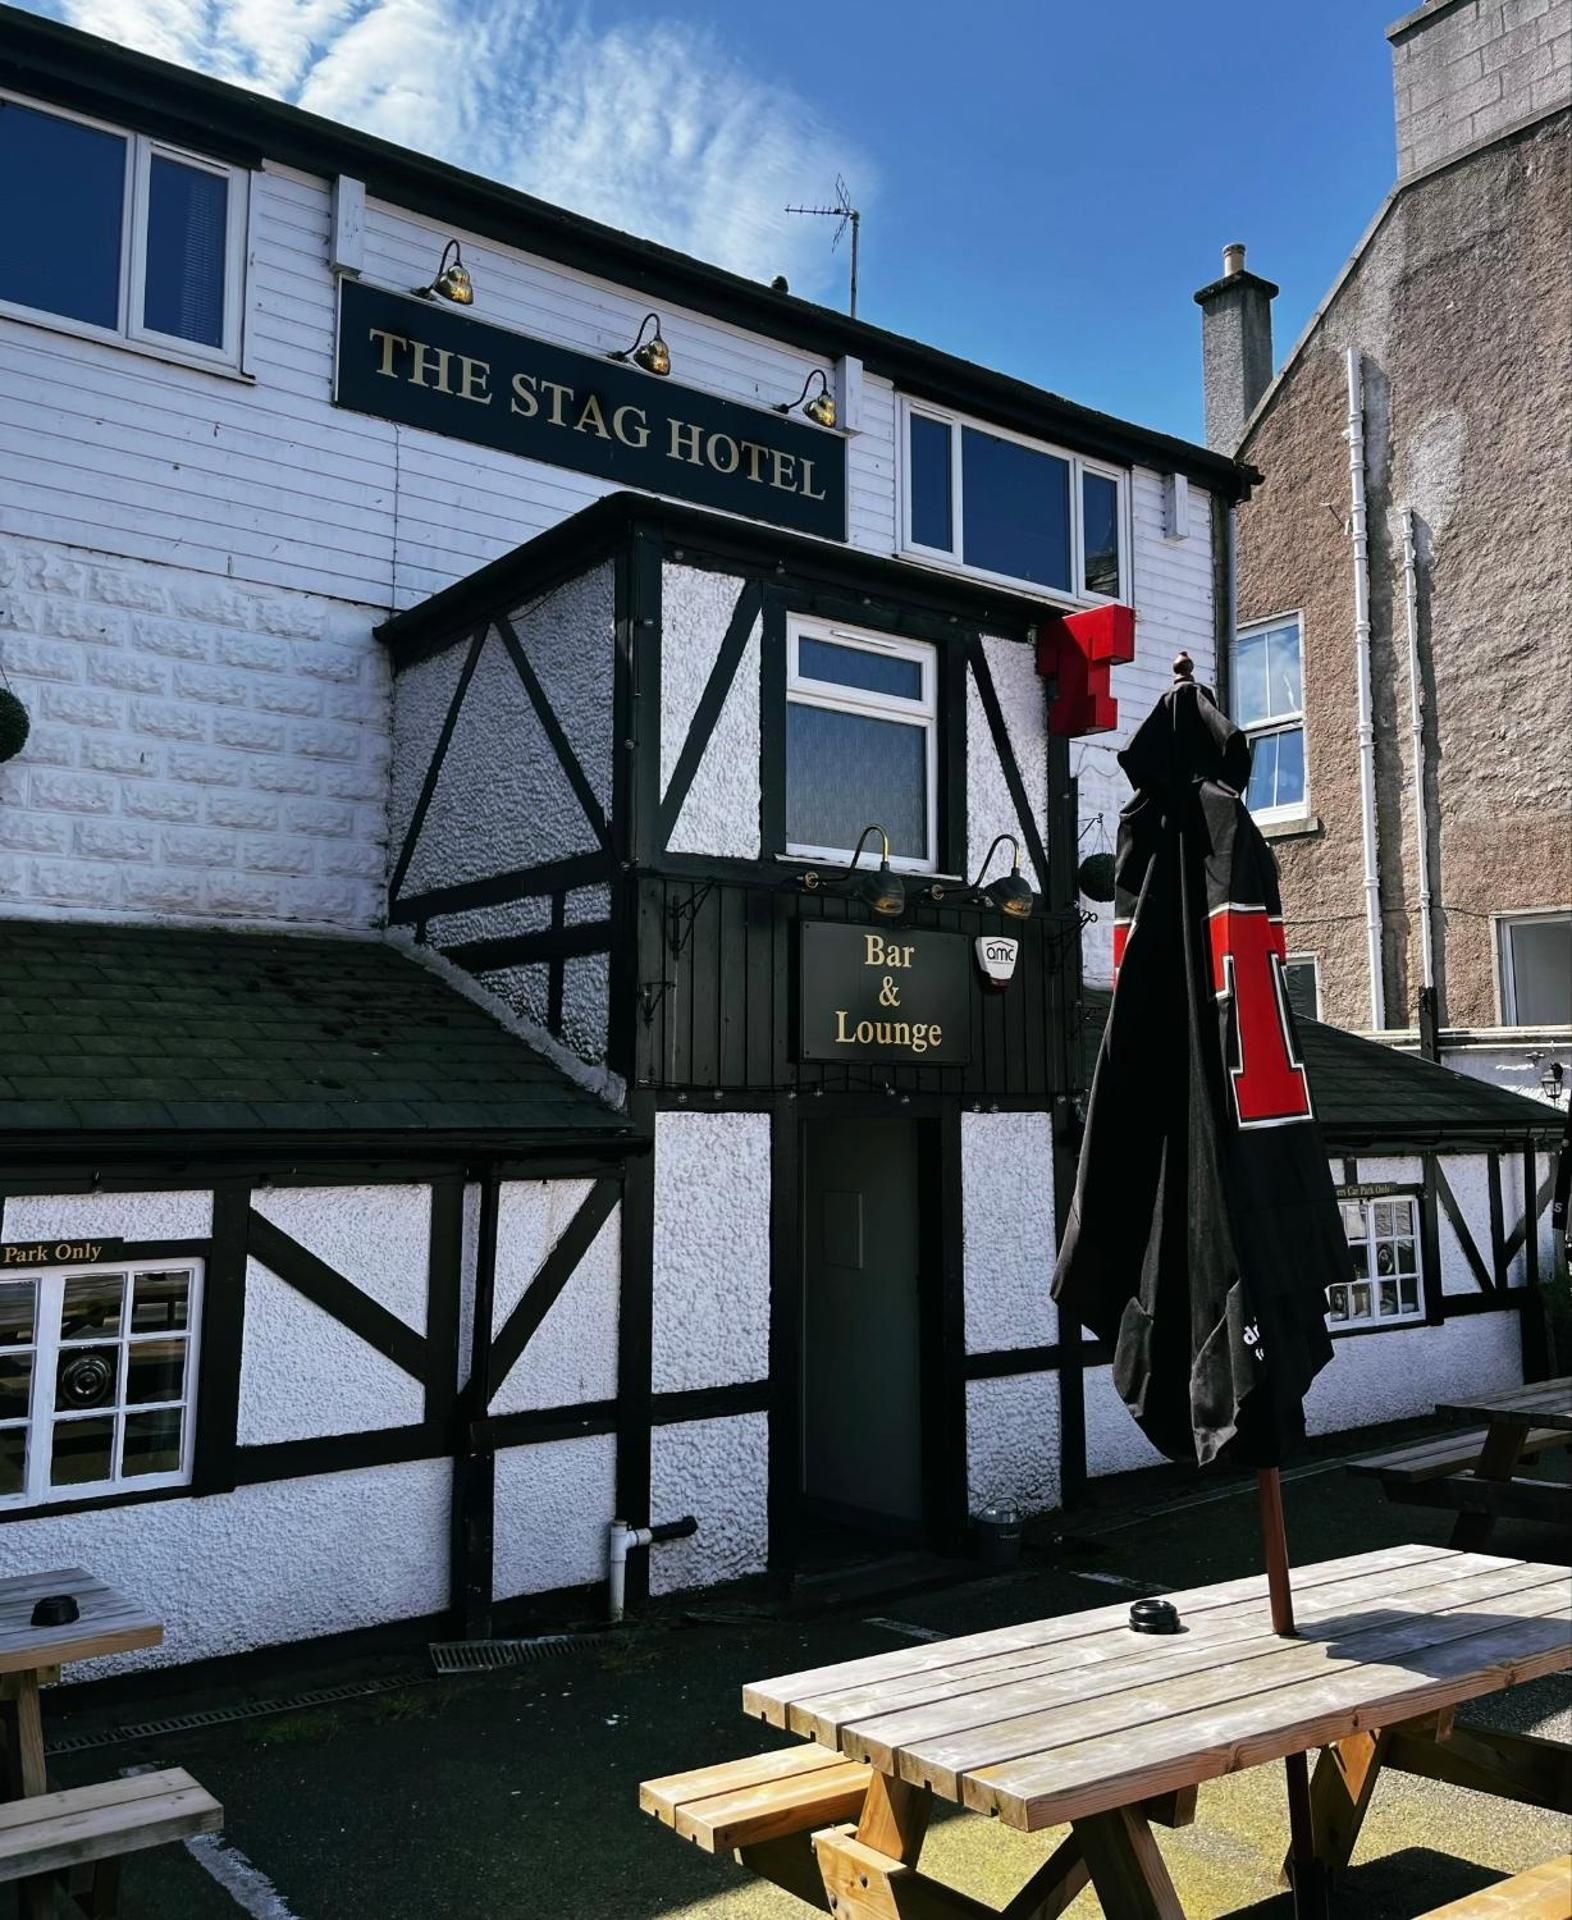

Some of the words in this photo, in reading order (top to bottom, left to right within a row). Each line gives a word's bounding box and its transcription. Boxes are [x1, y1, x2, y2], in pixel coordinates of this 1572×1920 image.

[369, 328, 494, 405] THE
[510, 372, 651, 448] STAG
[666, 417, 827, 501] HOTEL
[863, 934, 915, 969] Bar
[986, 946, 1015, 962] amc
[878, 975, 901, 1007] &
[834, 1010, 943, 1053] Lounge
[3, 1244, 49, 1263] Park
[55, 1242, 103, 1262] Only
